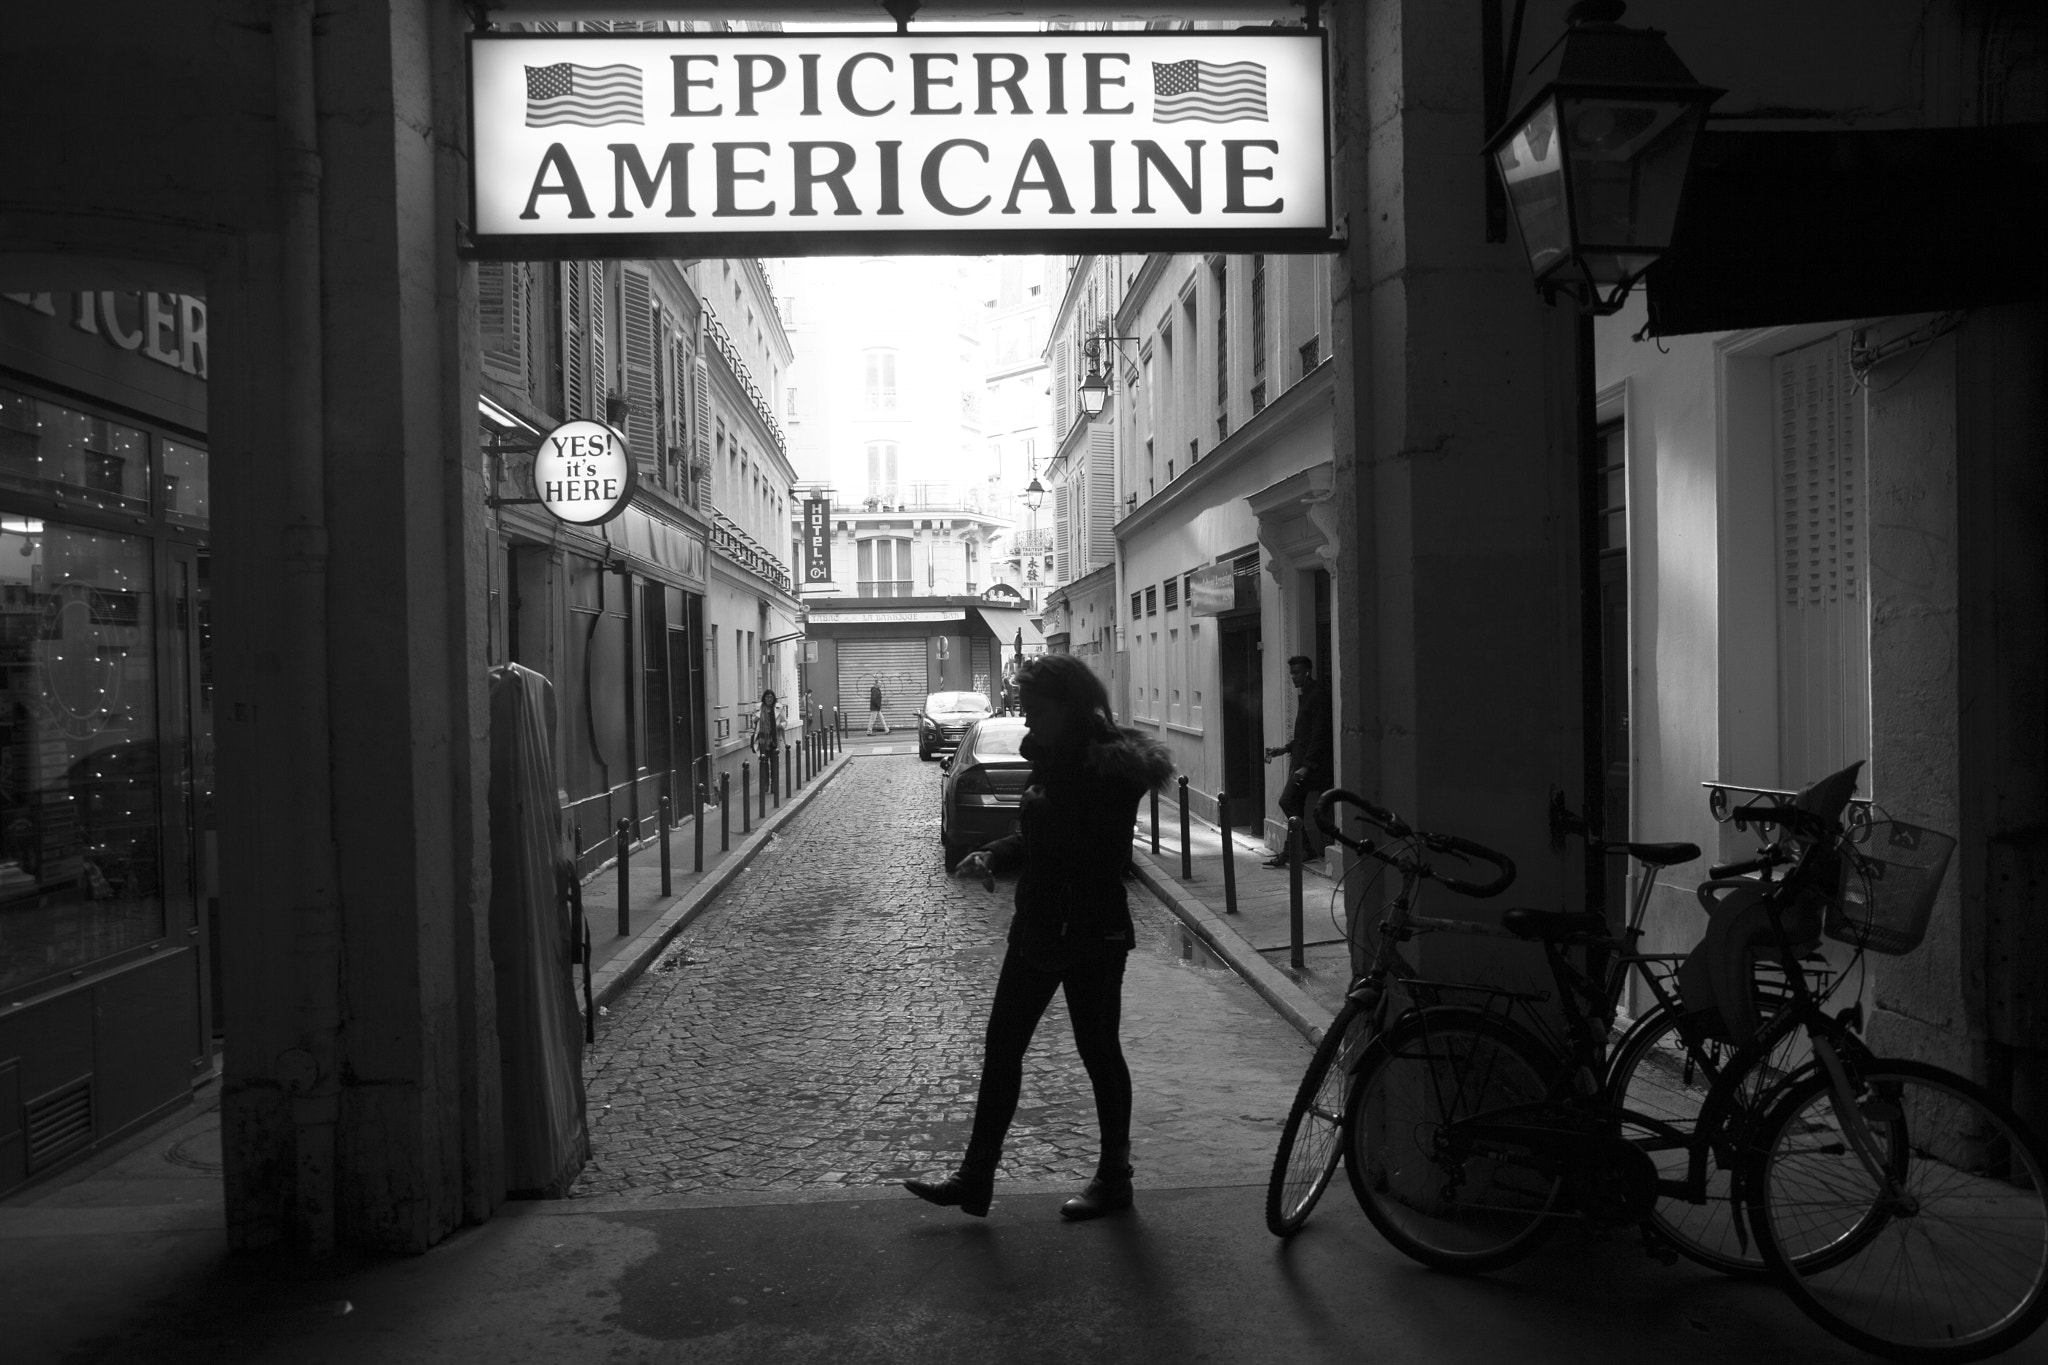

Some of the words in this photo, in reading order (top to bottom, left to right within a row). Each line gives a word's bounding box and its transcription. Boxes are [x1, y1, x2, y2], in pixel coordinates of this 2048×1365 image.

[669, 53, 1134, 117] EPICERIE
[518, 138, 1284, 220] AMERICAINE
[550, 434, 613, 458] YES!
[566, 459, 597, 477] it's
[545, 479, 619, 503] HERE
[811, 614, 839, 622] TABAC
